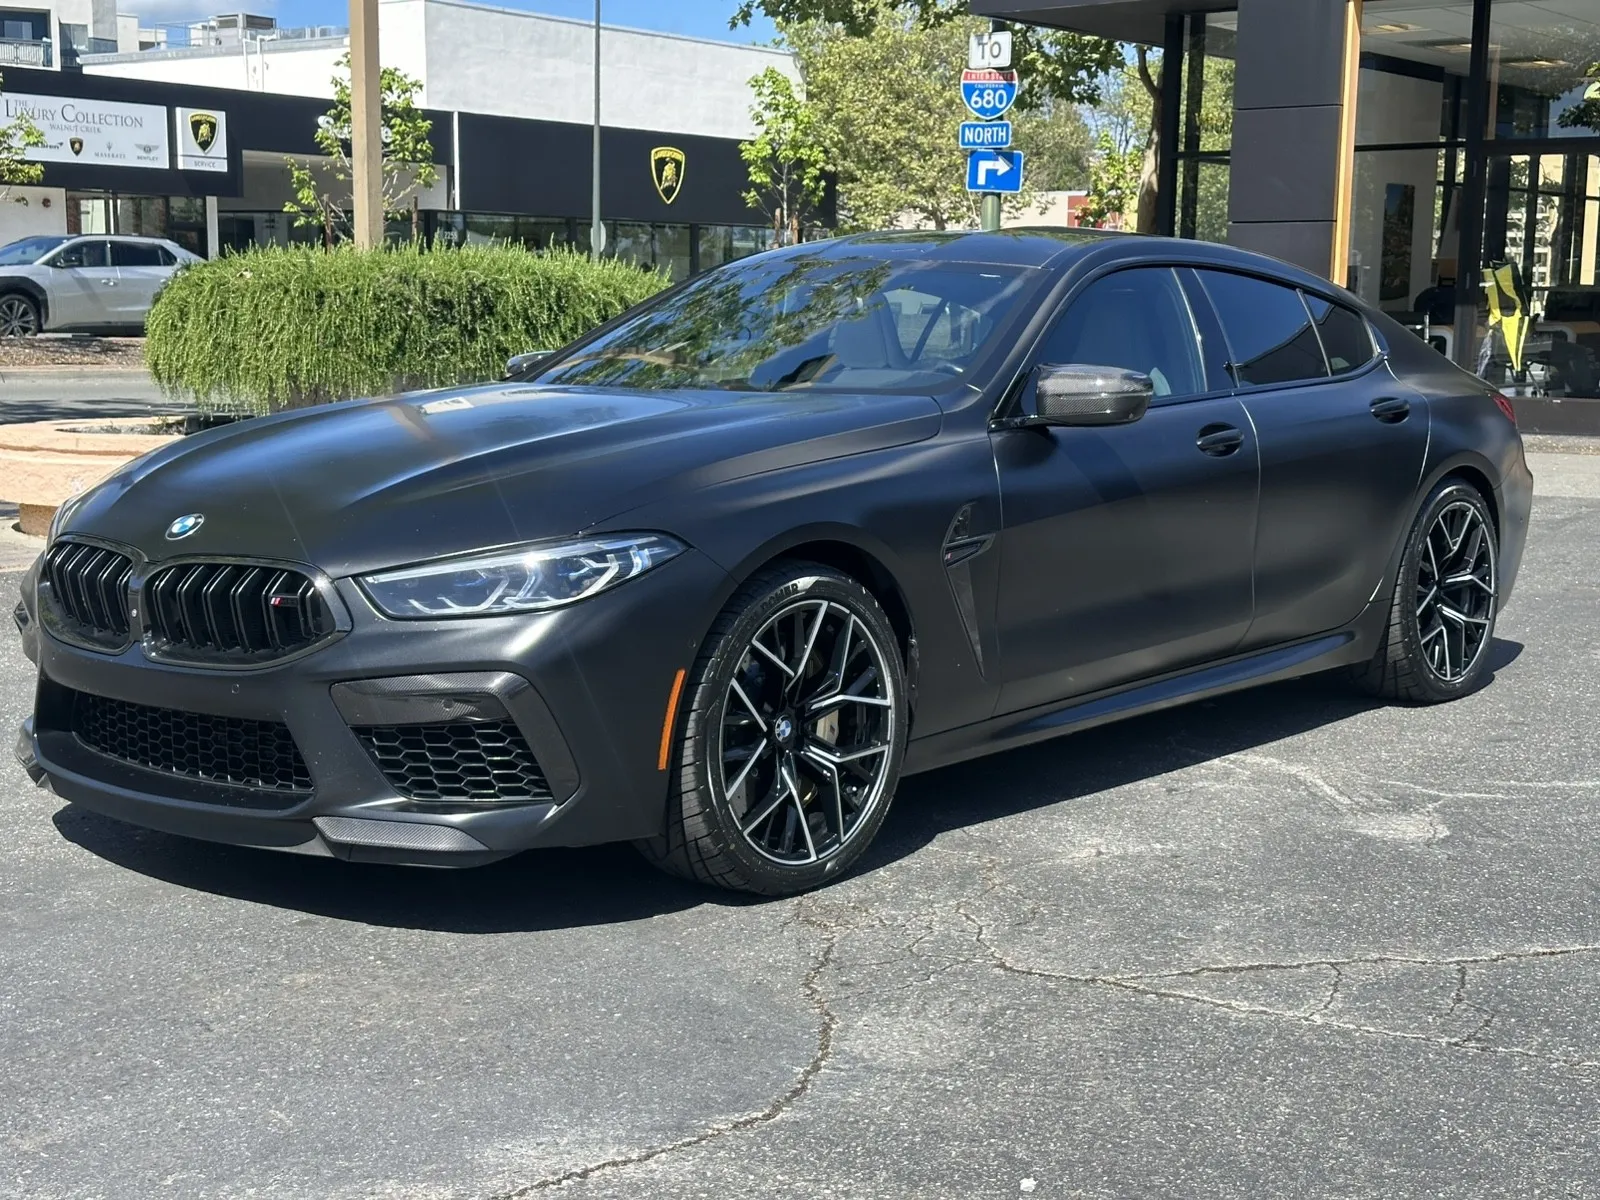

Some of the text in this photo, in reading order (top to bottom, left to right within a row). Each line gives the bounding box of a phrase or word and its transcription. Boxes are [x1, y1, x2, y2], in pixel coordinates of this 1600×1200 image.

[977, 41, 1002, 60] TO
[967, 72, 1012, 81] INTERSTATE
[970, 89, 1008, 109] 680
[964, 126, 1007, 143] NORTH
[194, 160, 217, 169] SERVICE
